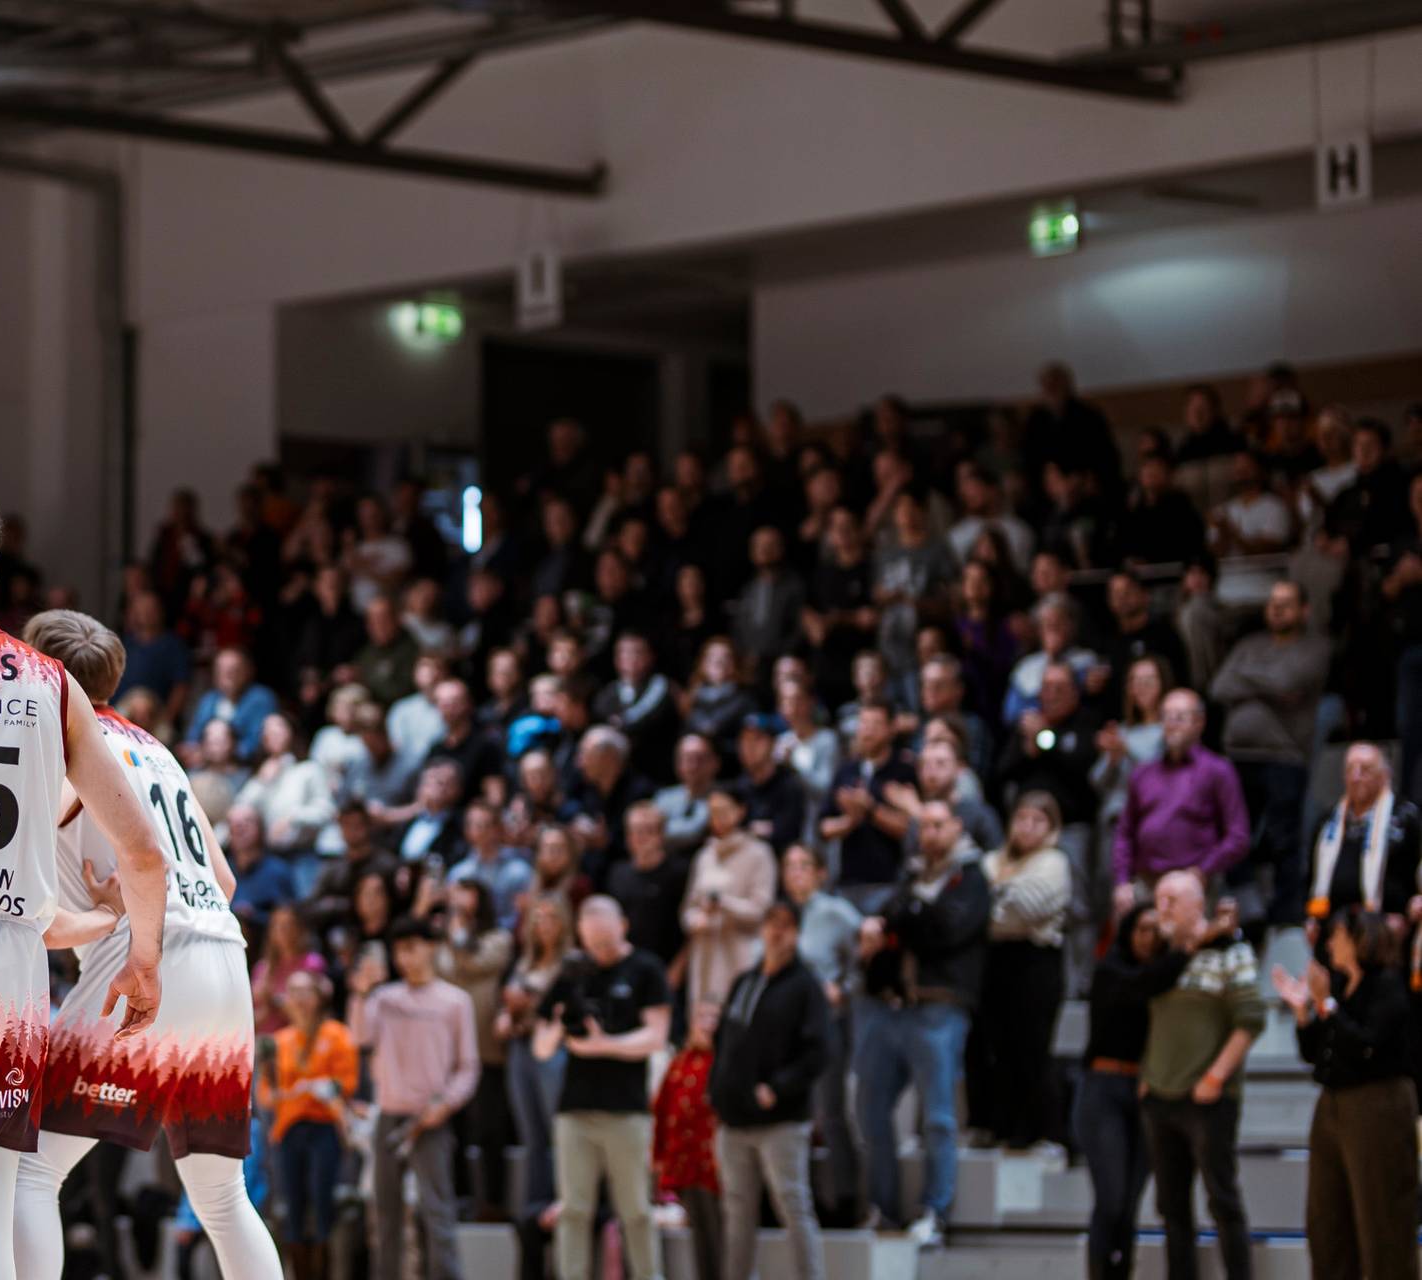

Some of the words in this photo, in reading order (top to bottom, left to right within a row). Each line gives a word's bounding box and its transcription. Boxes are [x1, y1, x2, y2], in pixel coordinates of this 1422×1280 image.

[1328, 143, 1358, 195] H
[3, 719, 37, 728] FAMILY
[149, 783, 207, 867] 16
[73, 1075, 137, 1104] better.
